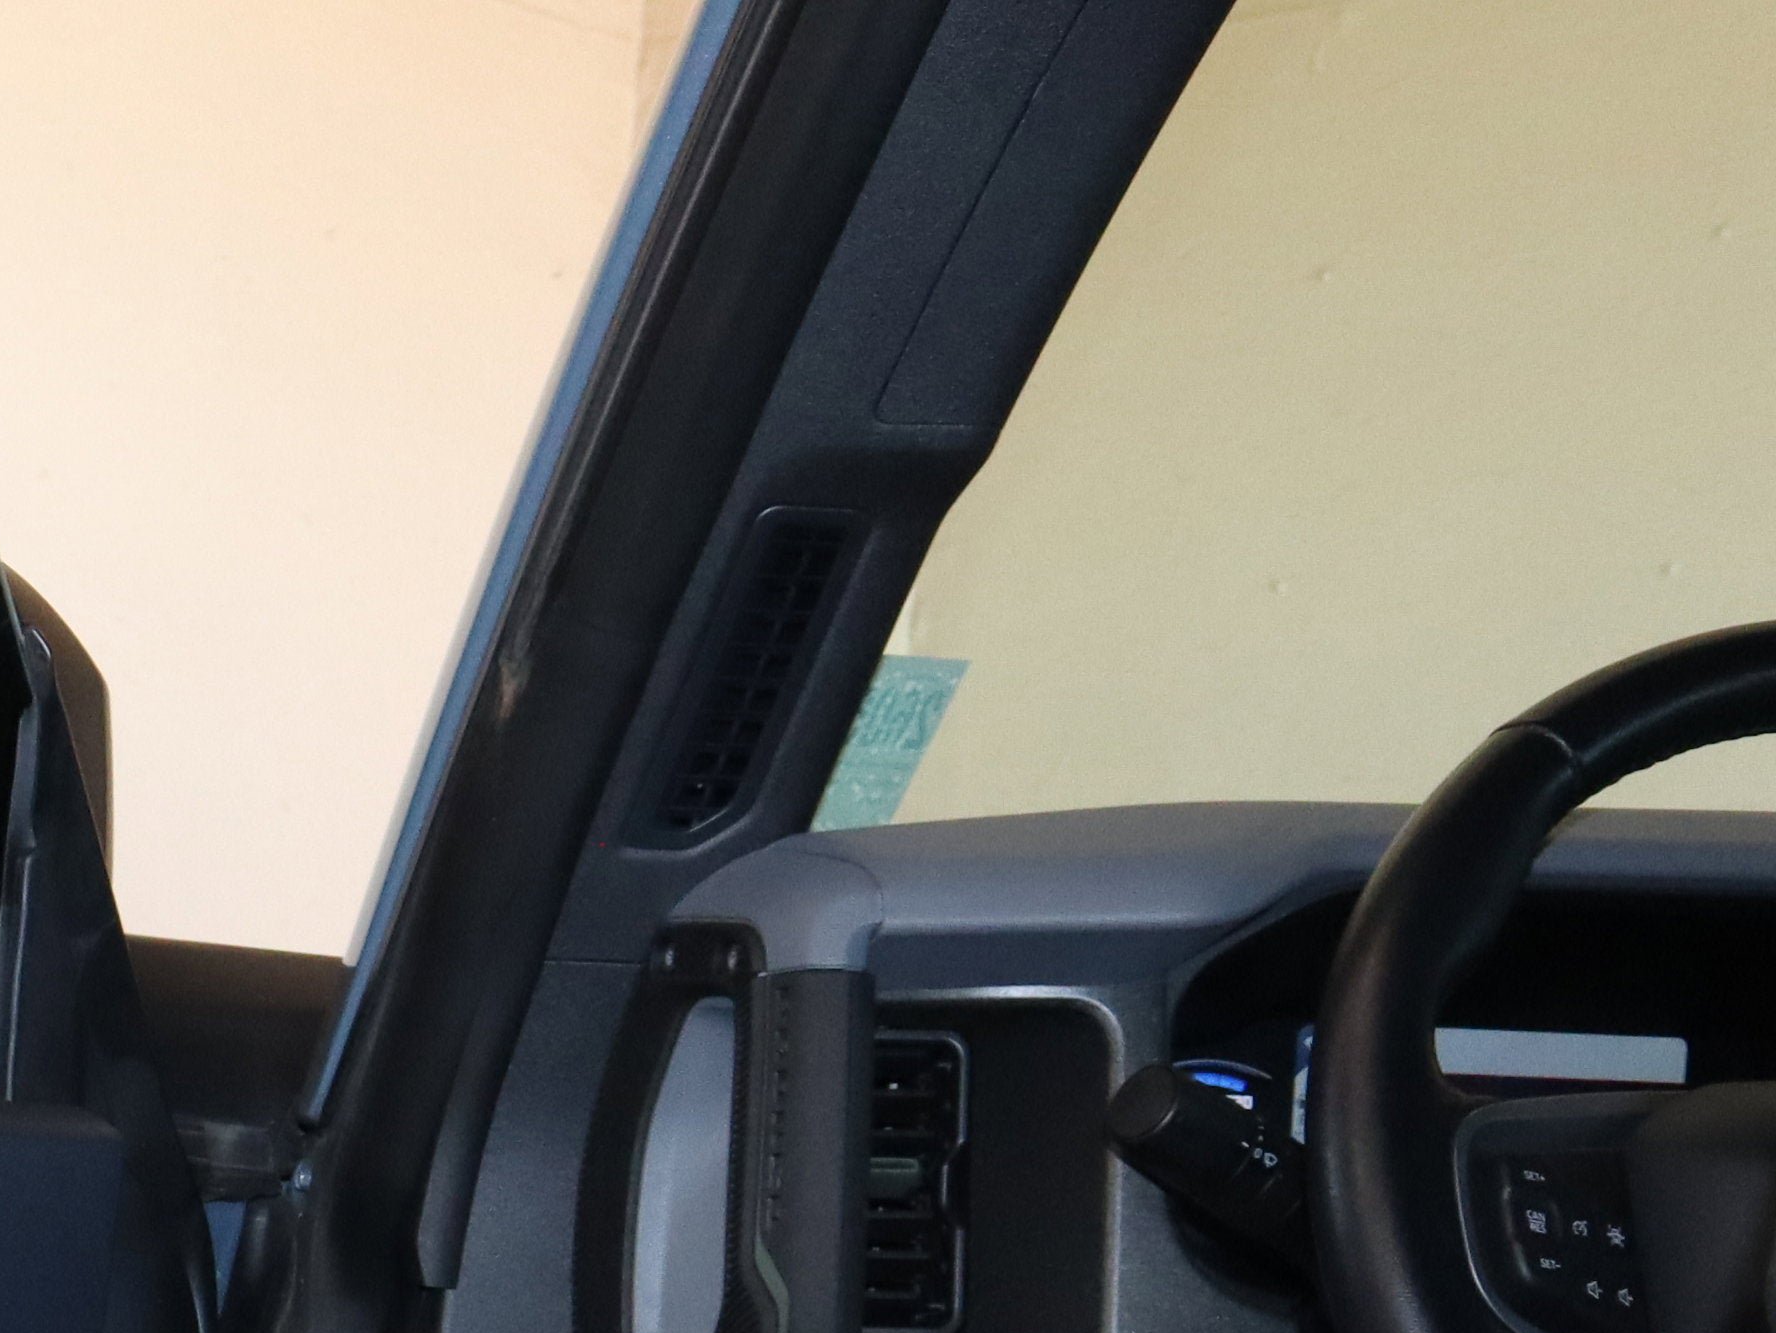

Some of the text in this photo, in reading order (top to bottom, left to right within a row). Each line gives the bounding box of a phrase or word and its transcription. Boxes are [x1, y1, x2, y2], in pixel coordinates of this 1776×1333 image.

[1523, 1170, 1546, 1182] SET+
[1525, 1209, 1546, 1222] CAN
[1540, 1258, 1562, 1270] SET-
